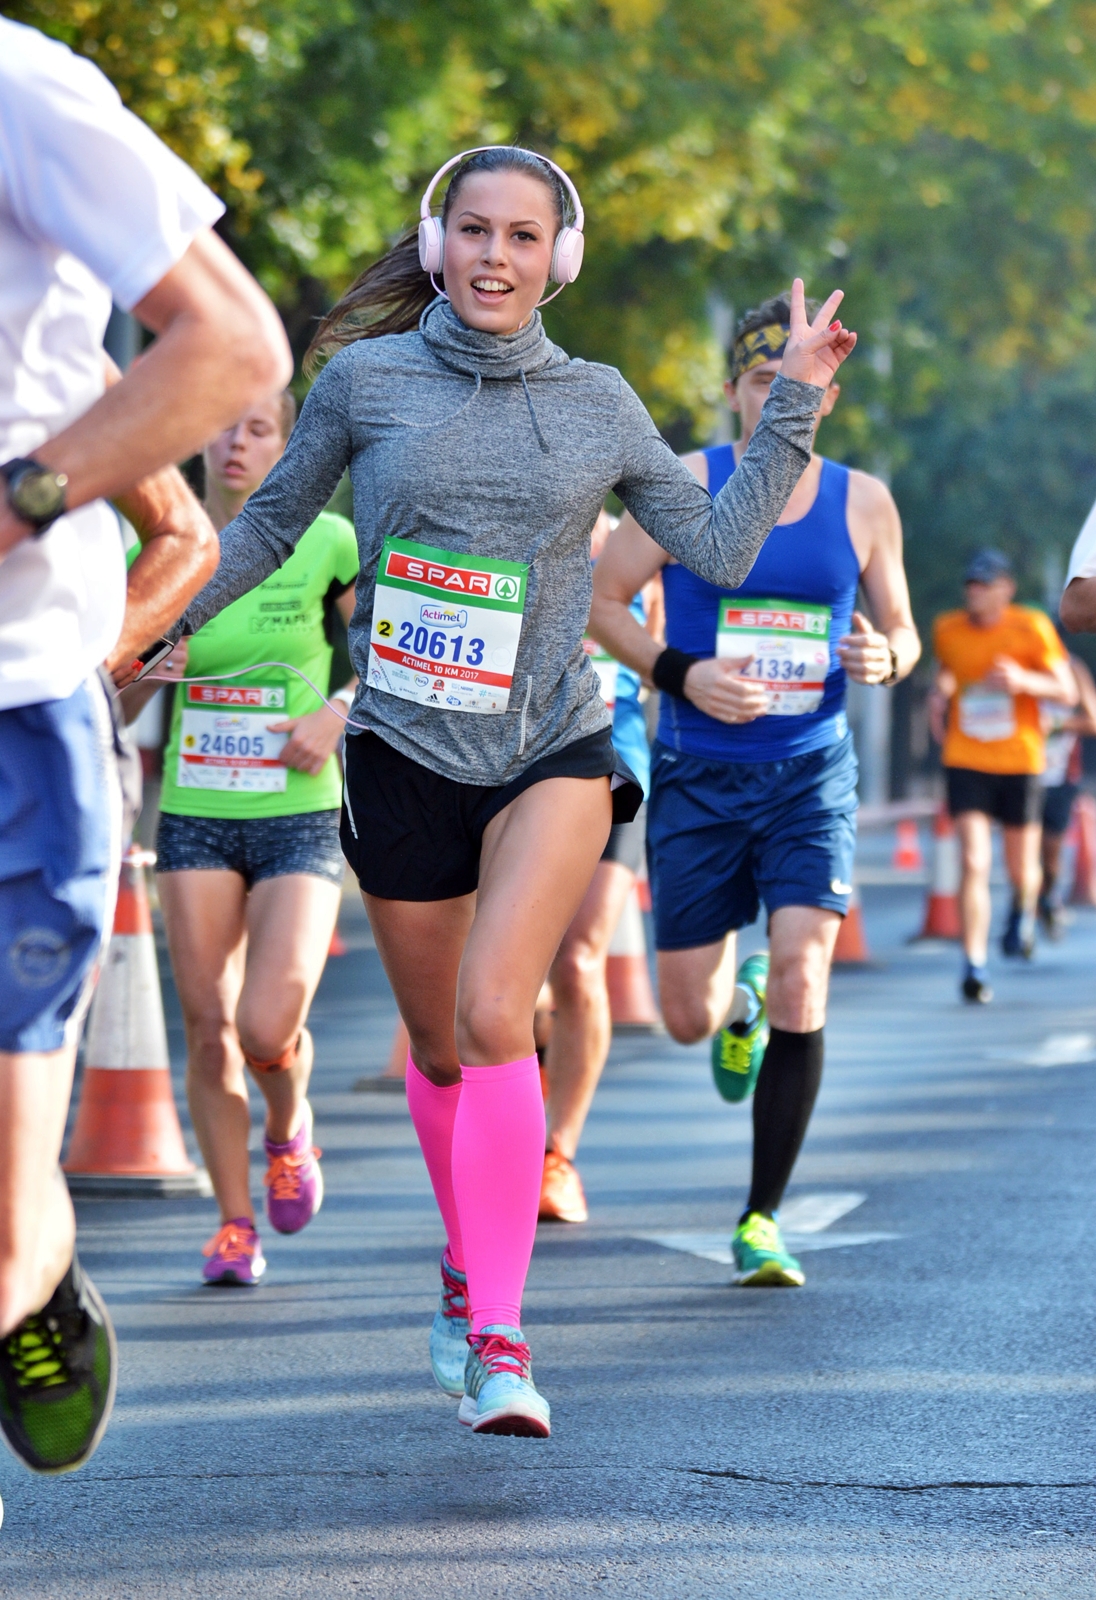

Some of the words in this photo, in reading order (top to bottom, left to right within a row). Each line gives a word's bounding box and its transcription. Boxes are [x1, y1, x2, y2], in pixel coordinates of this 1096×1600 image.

[406, 562, 488, 592] SPAR
[422, 609, 460, 622] Actimel
[741, 612, 804, 628] SPAR
[378, 621, 391, 637] 2
[397, 621, 485, 666] 20613
[401, 655, 432, 672] ACTIMEL
[433, 665, 444, 674] 10
[444, 667, 458, 677] KM
[459, 670, 479, 680] 2017
[200, 689, 261, 705] SPAR
[200, 733, 265, 757] 24605
